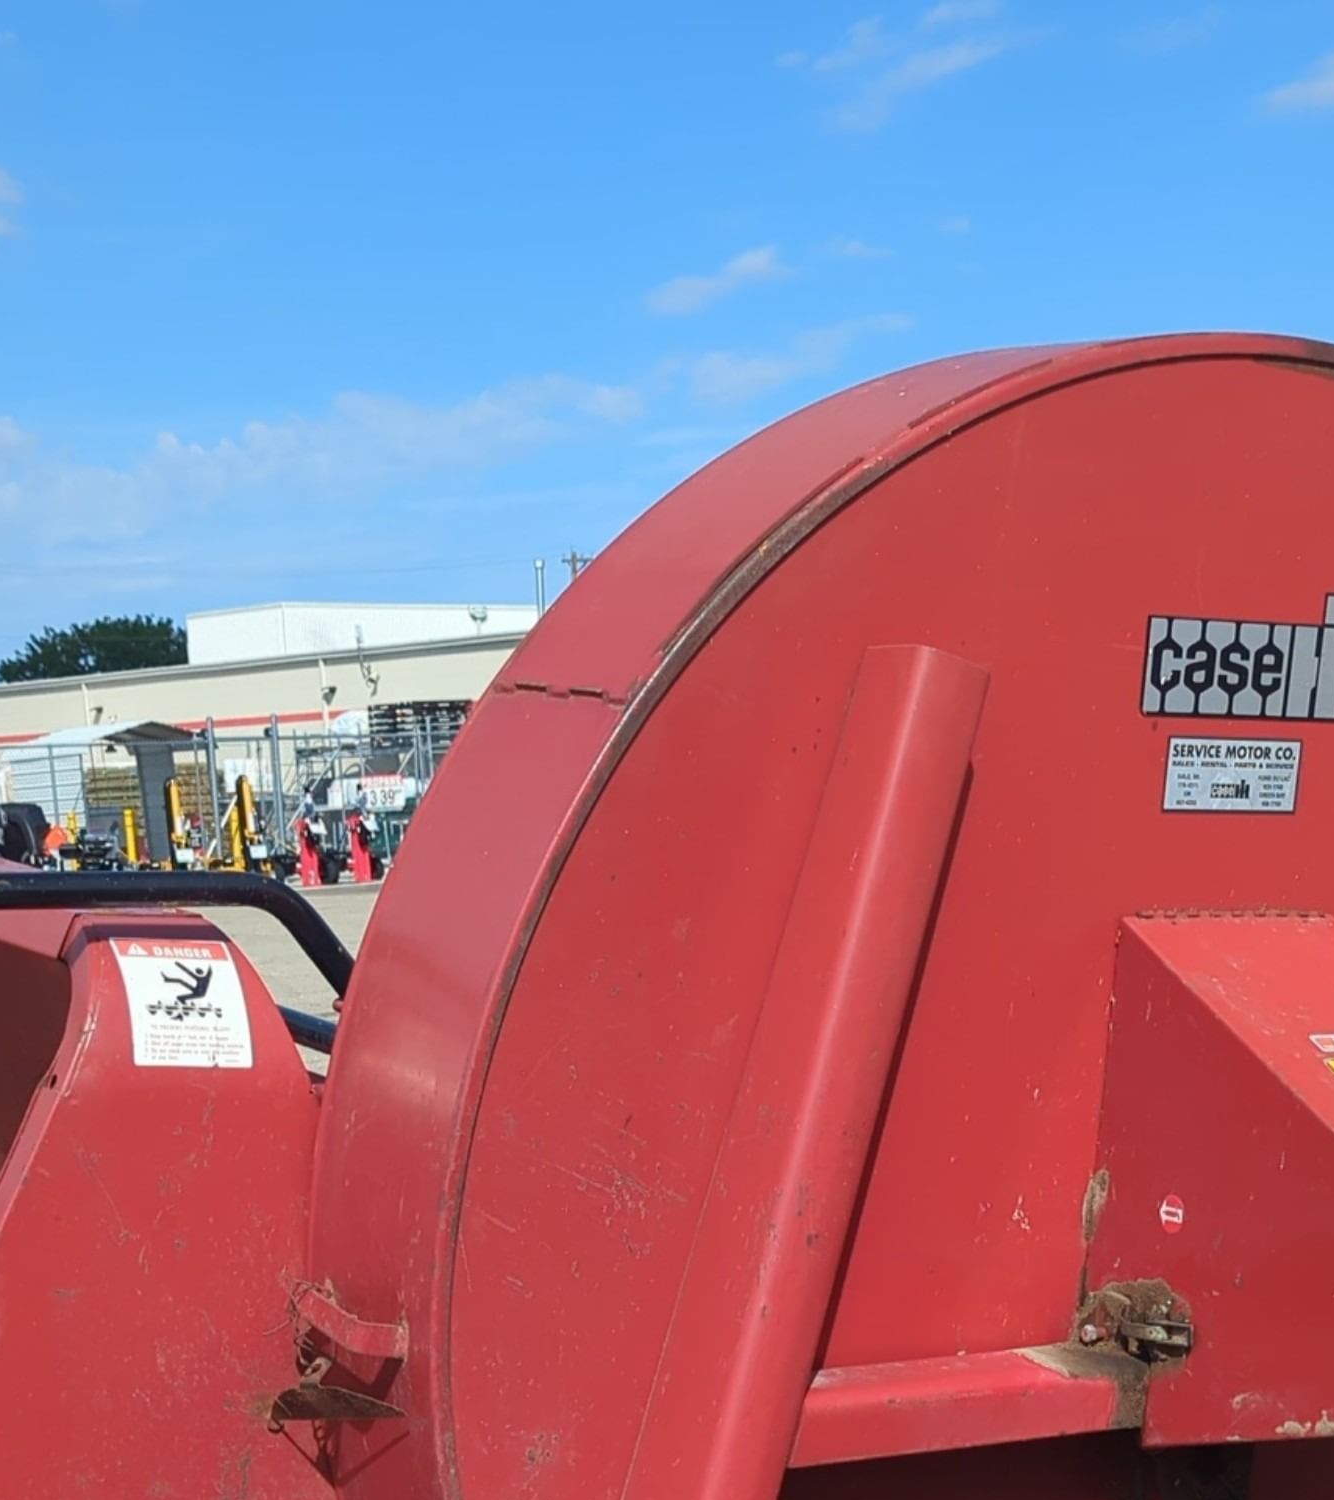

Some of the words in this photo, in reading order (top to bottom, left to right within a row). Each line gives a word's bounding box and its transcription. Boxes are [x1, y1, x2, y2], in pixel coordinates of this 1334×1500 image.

[1172, 744, 1222, 758] SERVICE
[1225, 745, 1271, 760] MOTOR
[1274, 747, 1296, 760] CO.
[152, 945, 213, 958] DANGER
